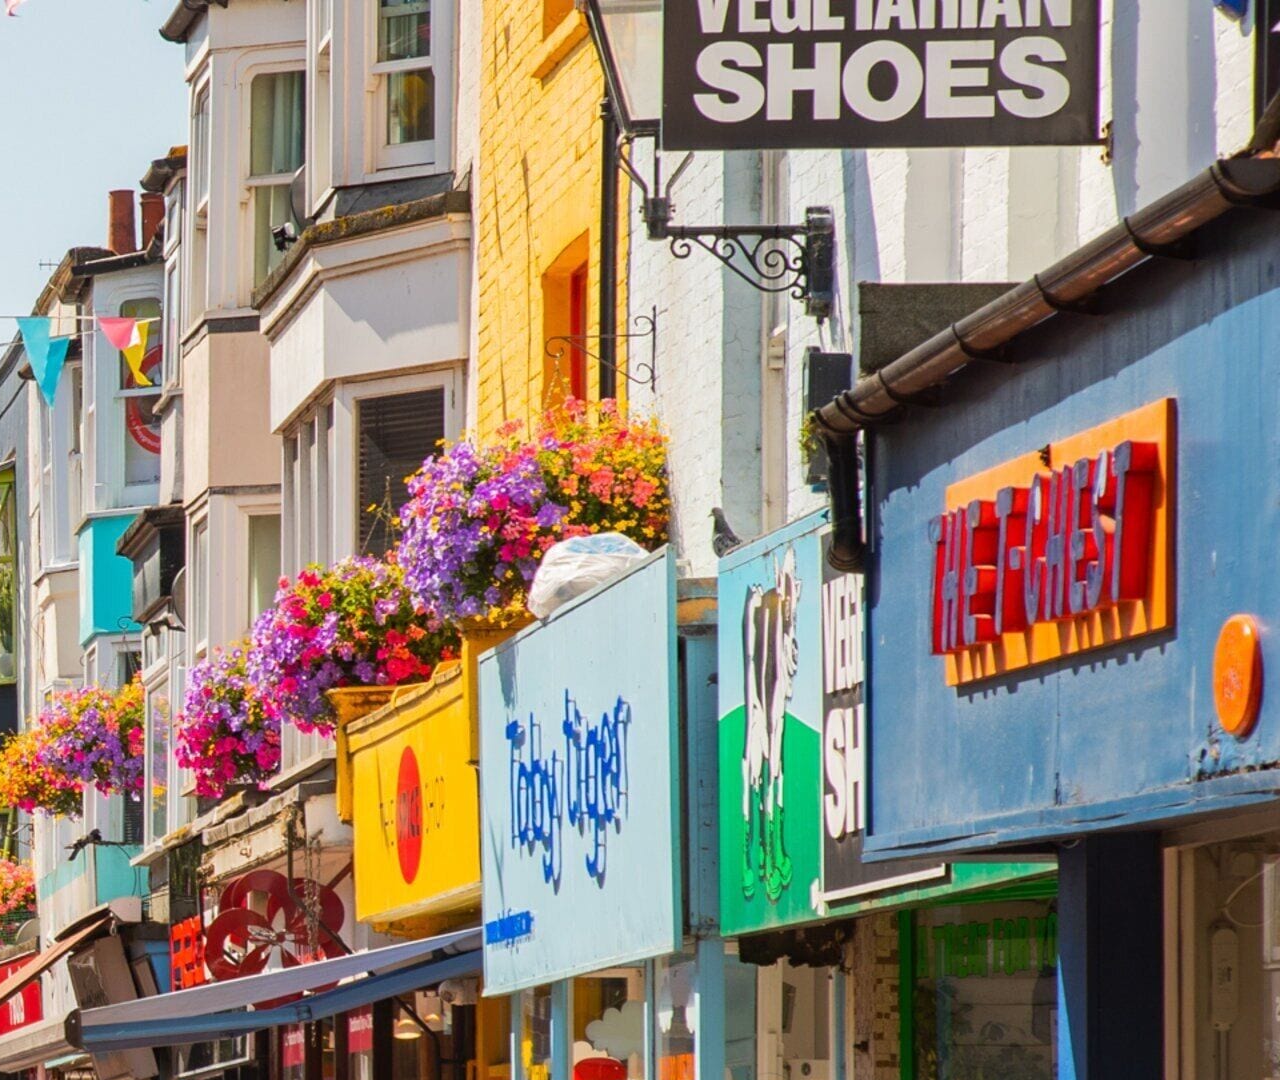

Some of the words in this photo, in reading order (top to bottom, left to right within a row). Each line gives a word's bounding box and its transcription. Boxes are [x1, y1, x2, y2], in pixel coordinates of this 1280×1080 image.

[693, 36, 1071, 123] SHOES
[929, 500, 996, 655] THE
[996, 440, 1159, 636] T-CHEST
[992, 916, 1030, 977] FOR
